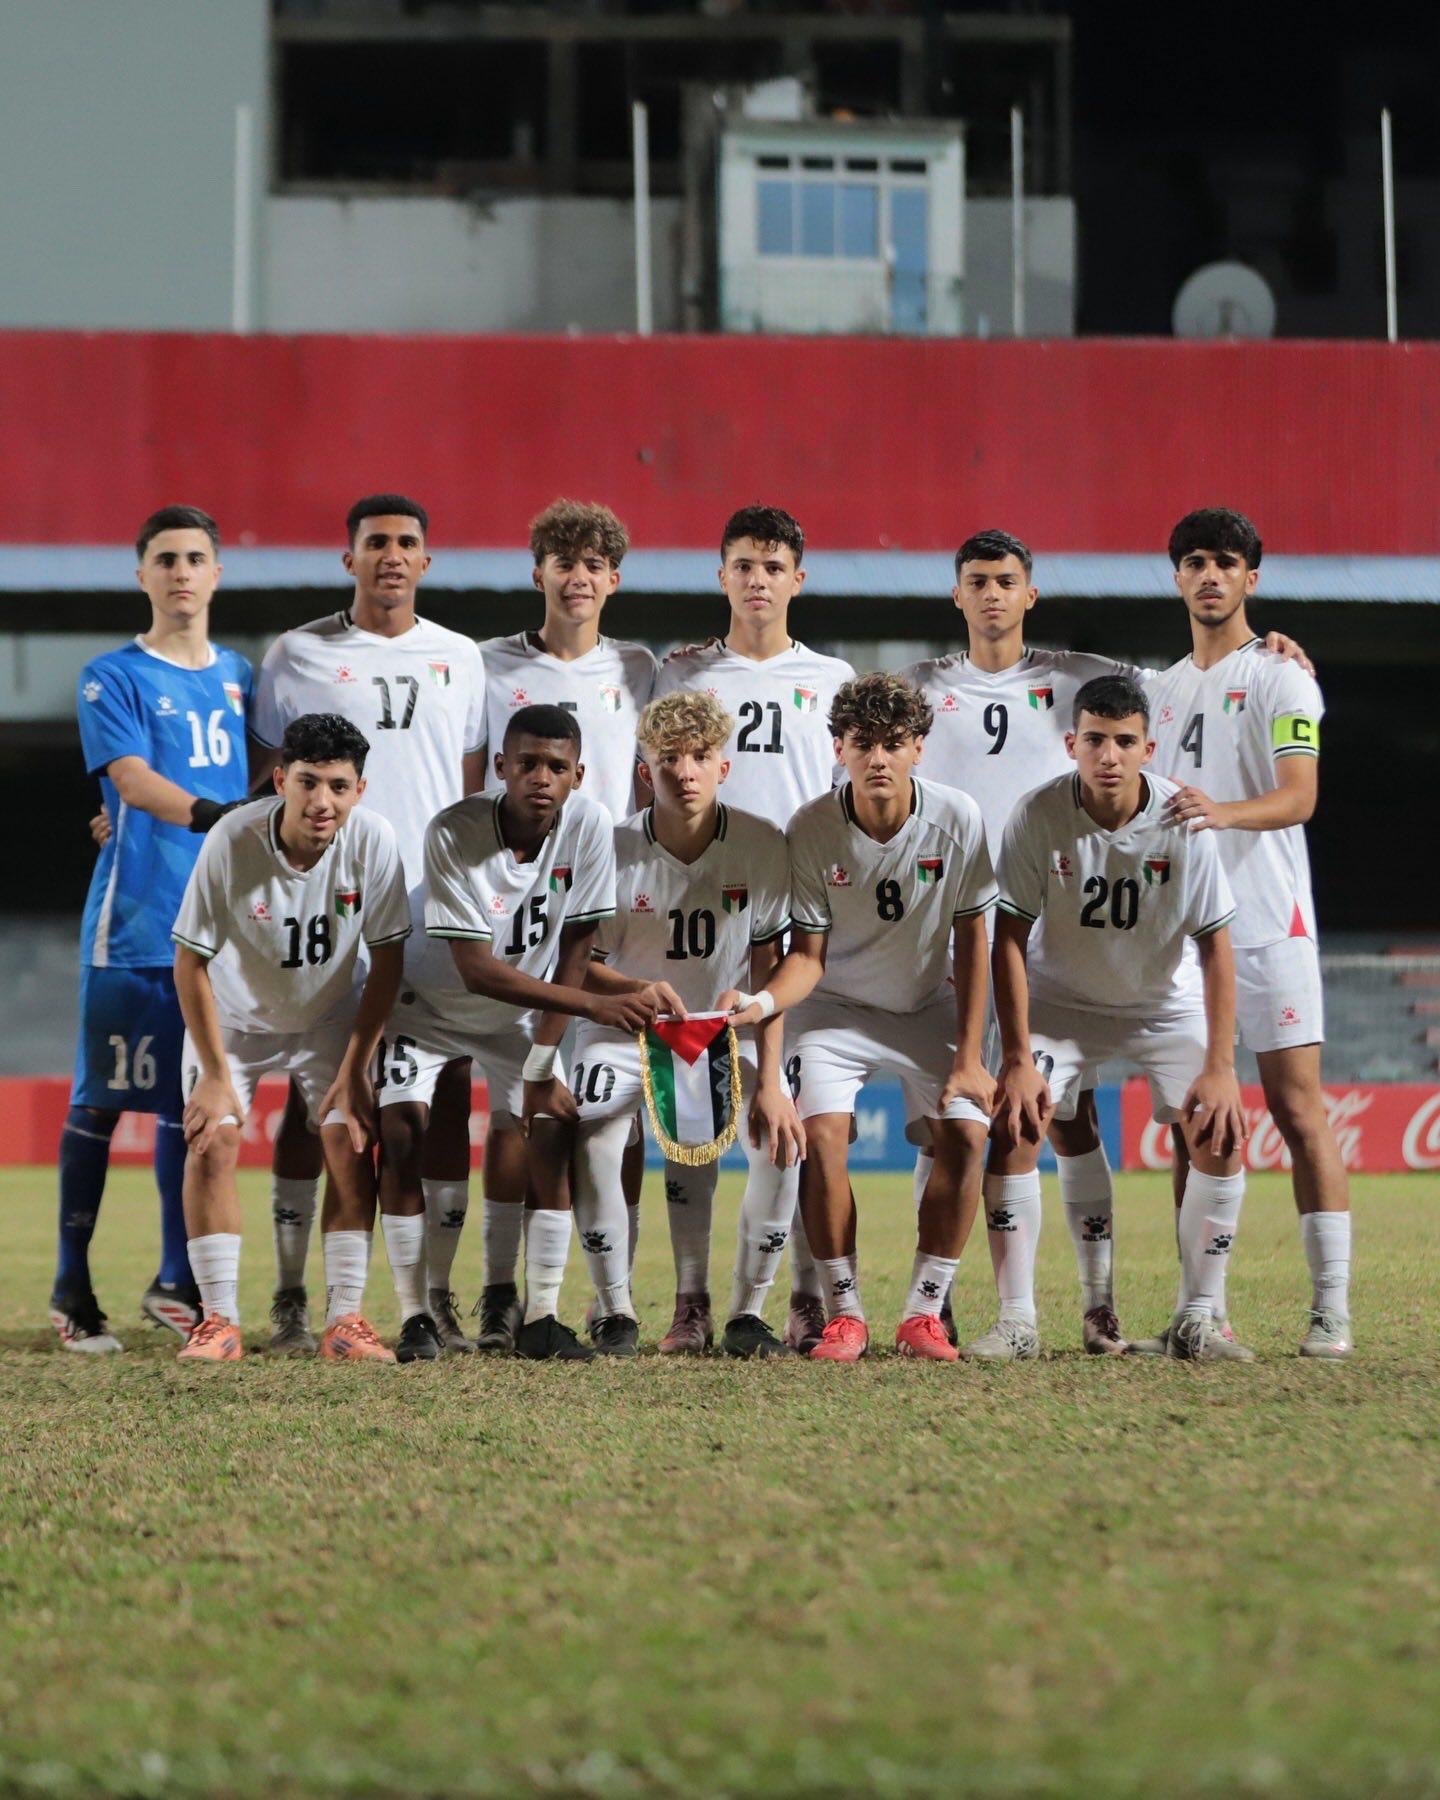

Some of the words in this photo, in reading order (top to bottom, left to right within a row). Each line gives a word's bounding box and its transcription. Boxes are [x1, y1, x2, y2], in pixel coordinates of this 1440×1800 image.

[372, 676, 419, 730] 17
[737, 700, 784, 754] 21
[983, 702, 1008, 755] 9
[1292, 718, 1311, 742] C
[186, 710, 231, 768] 16
[1181, 713, 1204, 768] 4
[505, 894, 549, 956] 15
[876, 878, 904, 922] 8
[1080, 875, 1139, 930] 20
[280, 914, 332, 969] 18
[666, 908, 716, 960] 10
[107, 1035, 156, 1091] 16
[374, 1034, 418, 1090] 15
[573, 1061, 616, 1107] 10
